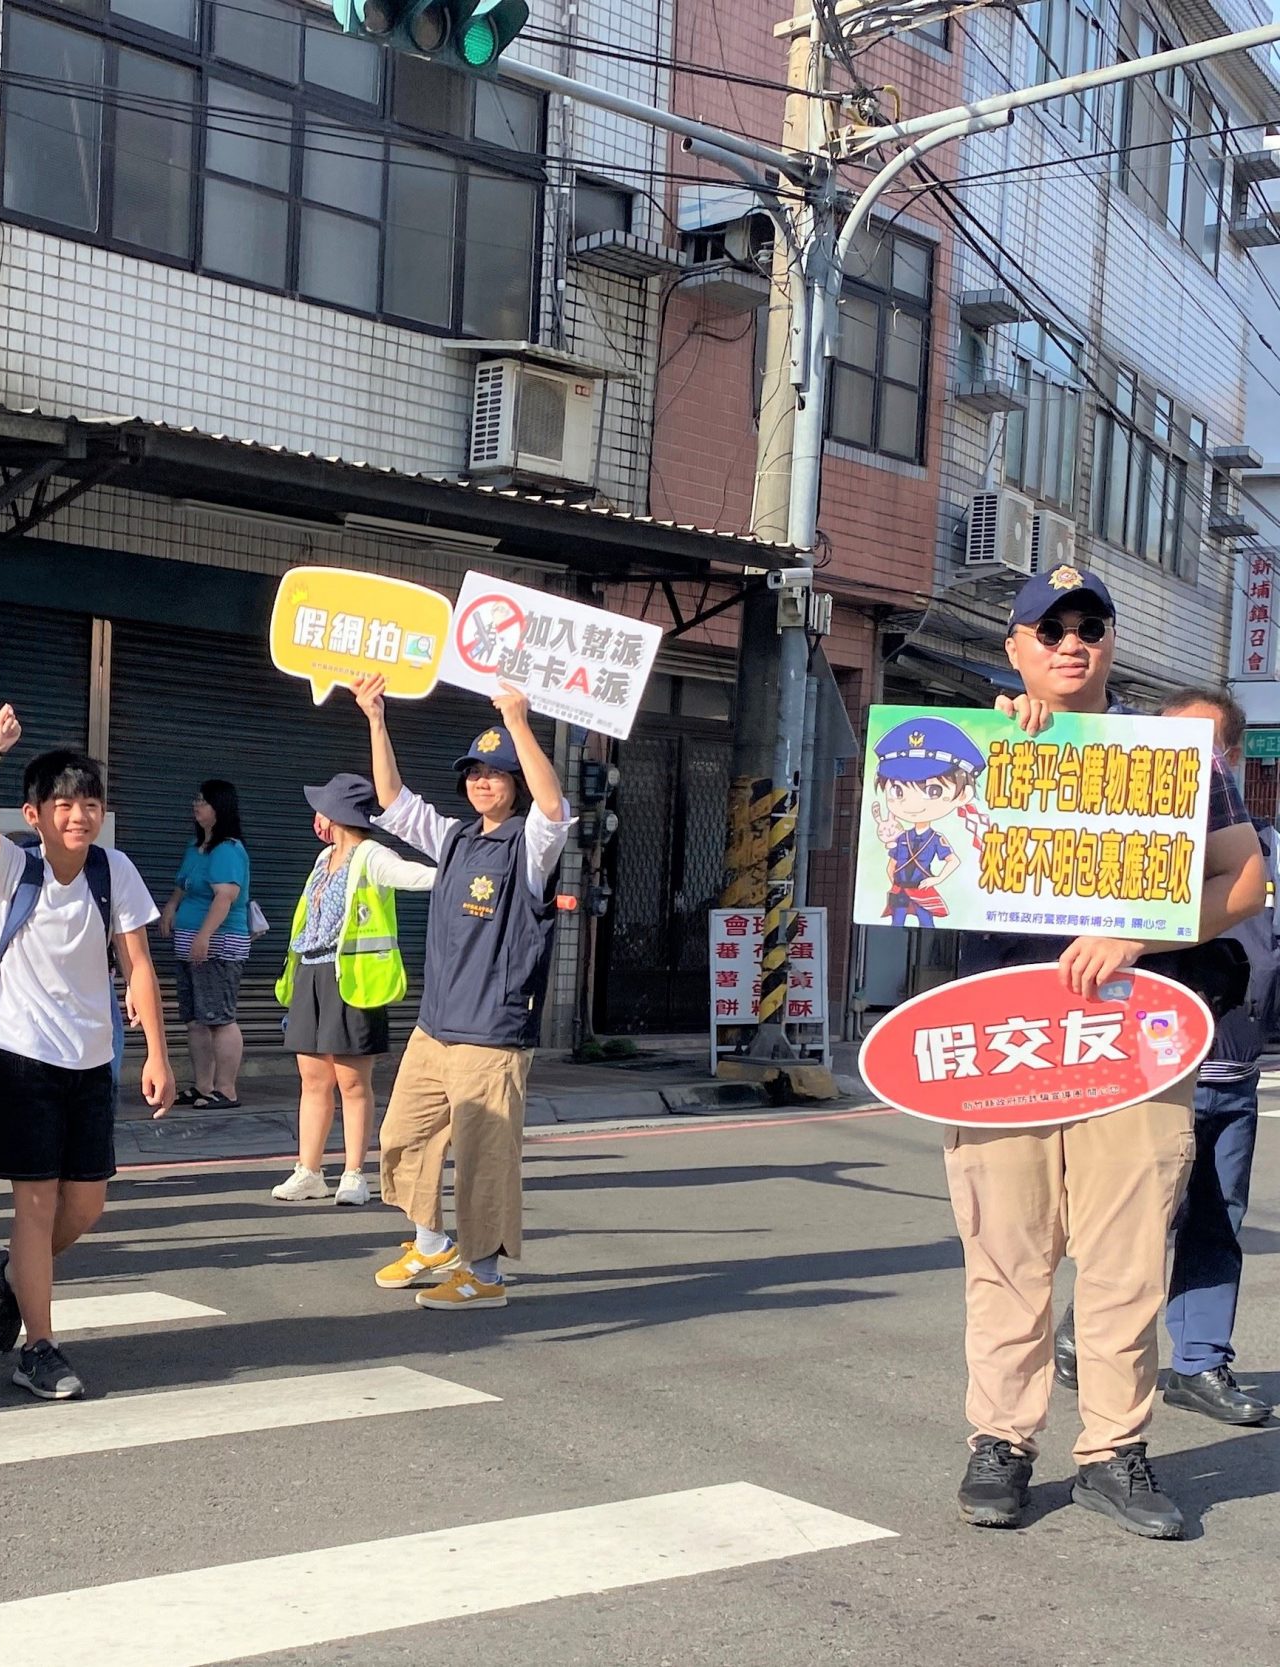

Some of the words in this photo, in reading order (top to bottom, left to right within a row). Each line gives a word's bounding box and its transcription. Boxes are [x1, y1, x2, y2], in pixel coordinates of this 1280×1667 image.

[292, 604, 403, 665] 假網拍
[521, 610, 644, 668] 加入幫派
[1248, 558, 1272, 671] 新埔鎮召會
[496, 645, 631, 705] 逃卡A派
[1255, 735, 1280, 754] 中正
[985, 739, 1200, 818] 社群平台購物藏陷阱
[978, 823, 1195, 903] 來路不明包裹應拒收
[985, 910, 1125, 929] 新竹縣政府警察局新埔分局
[913, 1009, 1131, 1083] 假交友
